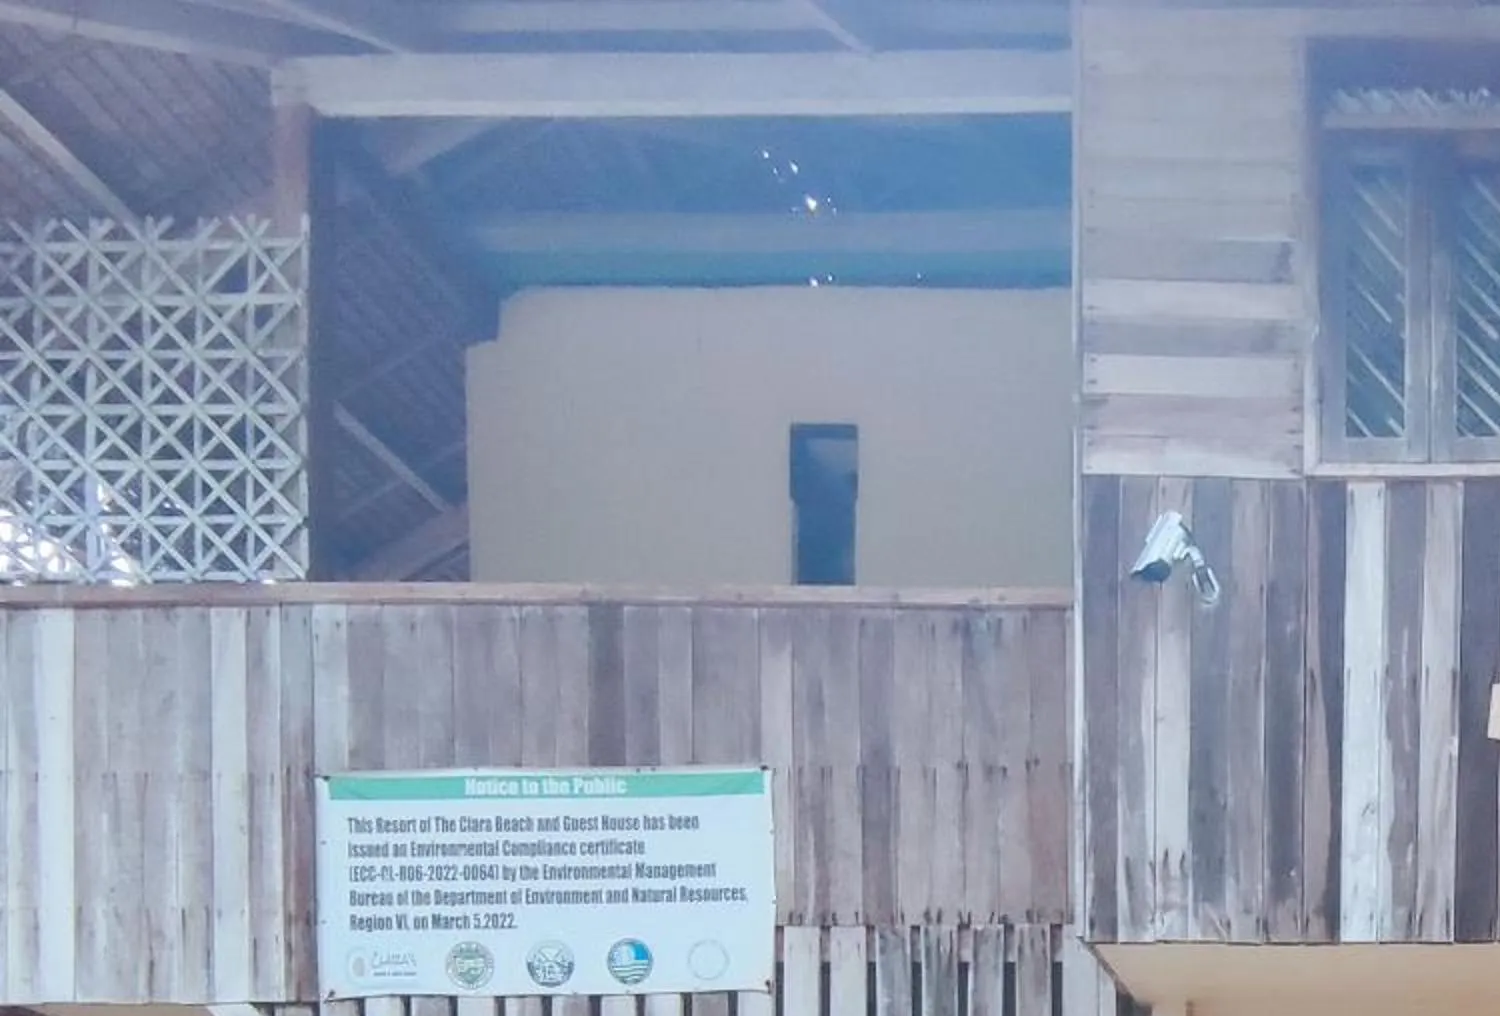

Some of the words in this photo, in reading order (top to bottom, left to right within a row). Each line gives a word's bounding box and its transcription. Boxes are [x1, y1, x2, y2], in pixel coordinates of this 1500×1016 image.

[464, 778, 519, 796] Notice
[522, 778, 538, 795] to
[542, 778, 569, 795] the
[574, 777, 628, 795] Public
[348, 817, 373, 834] This
[376, 817, 417, 834] Resort
[419, 817, 431, 833] of
[434, 816, 457, 833] The
[459, 816, 492, 833] Clara
[495, 816, 535, 833] Beach
[537, 815, 560, 832] and
[563, 815, 598, 832] Guest
[601, 815, 641, 832] House
[643, 814, 666, 831] has
[668, 814, 700, 830] been
[393, 843, 407, 857] an
[502, 840, 577, 858] Compliance
[579, 839, 646, 856] certificate
[502, 864, 517, 883] by
[519, 864, 539, 881] the
[635, 862, 717, 881] Management
[350, 890, 394, 907] Bureau
[396, 890, 409, 906] of
[411, 889, 431, 906] the
[433, 888, 508, 907] Department
[510, 888, 522, 905] of
[525, 887, 604, 905] Environment
[606, 887, 628, 903] and
[631, 886, 677, 903] Natural
[350, 914, 393, 933] Region
[413, 915, 429, 930] on
[431, 913, 471, 930] March
